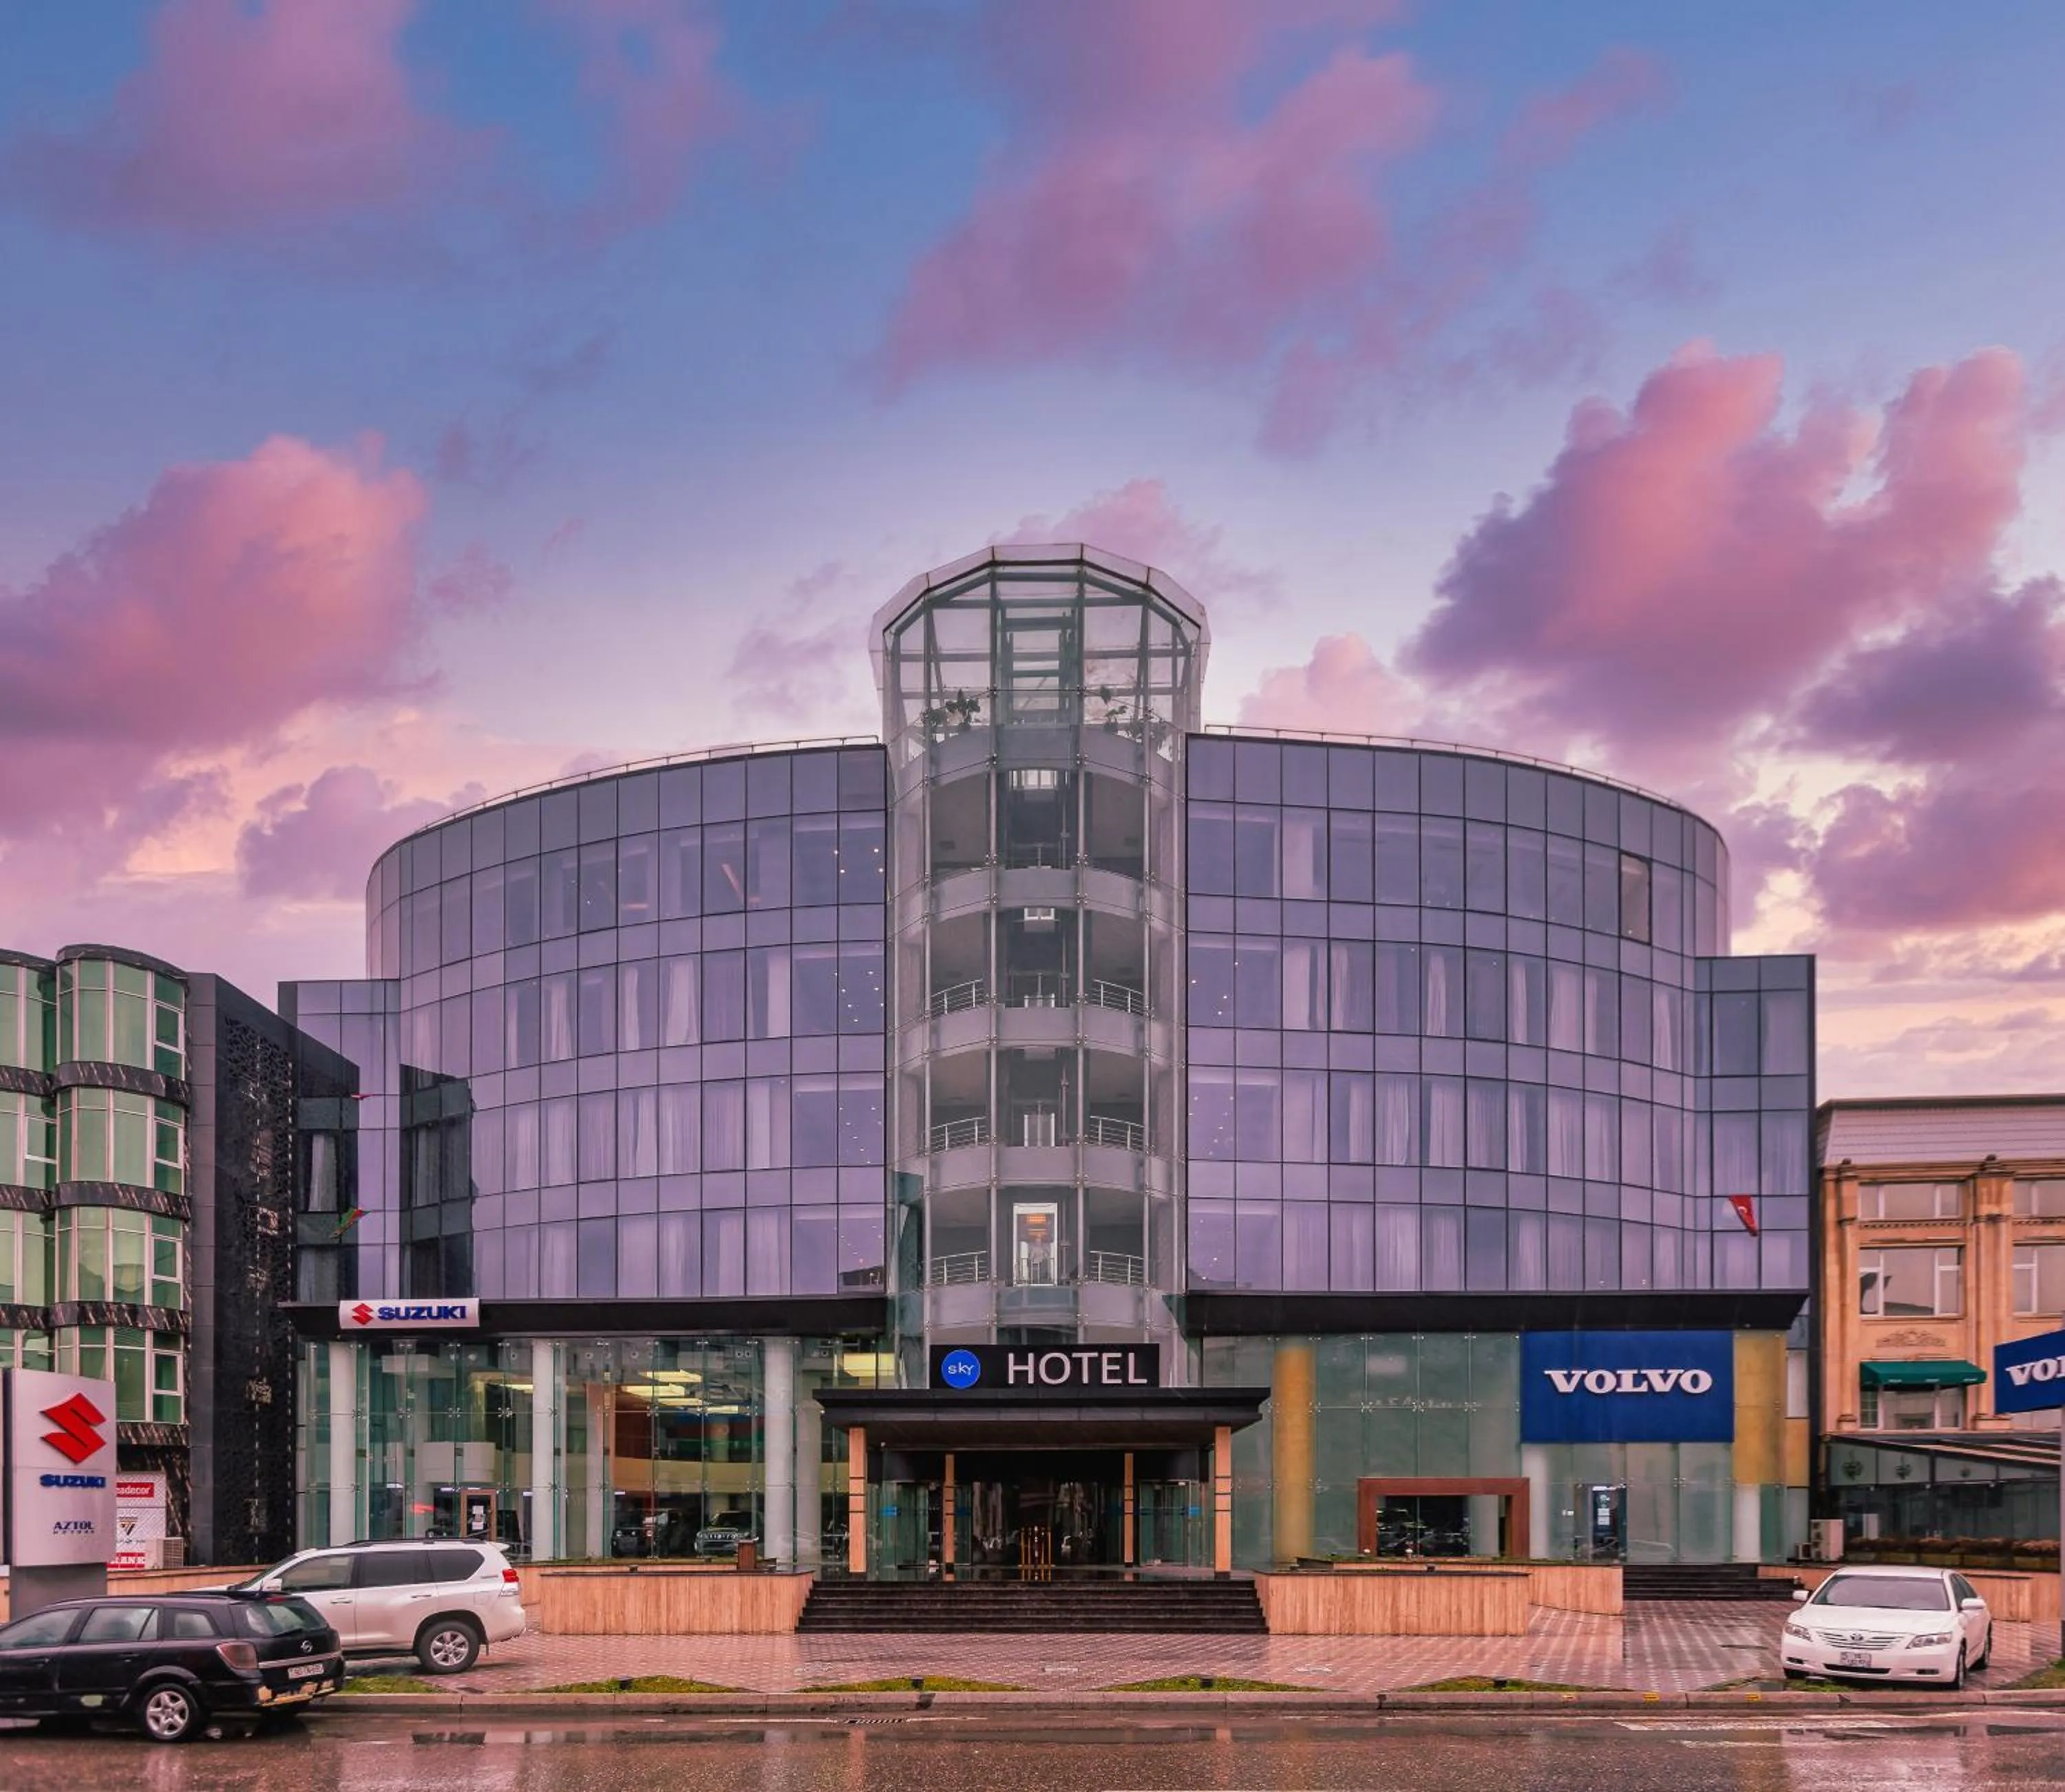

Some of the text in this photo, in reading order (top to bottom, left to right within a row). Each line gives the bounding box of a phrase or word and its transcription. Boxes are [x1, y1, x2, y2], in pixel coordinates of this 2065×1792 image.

[377, 1305, 467, 1321] SUZUKI
[948, 1352, 1148, 1385] sky HOTEL
[1543, 1369, 1713, 1394] VOLVO
[39, 1473, 107, 1489] SUZUKI
